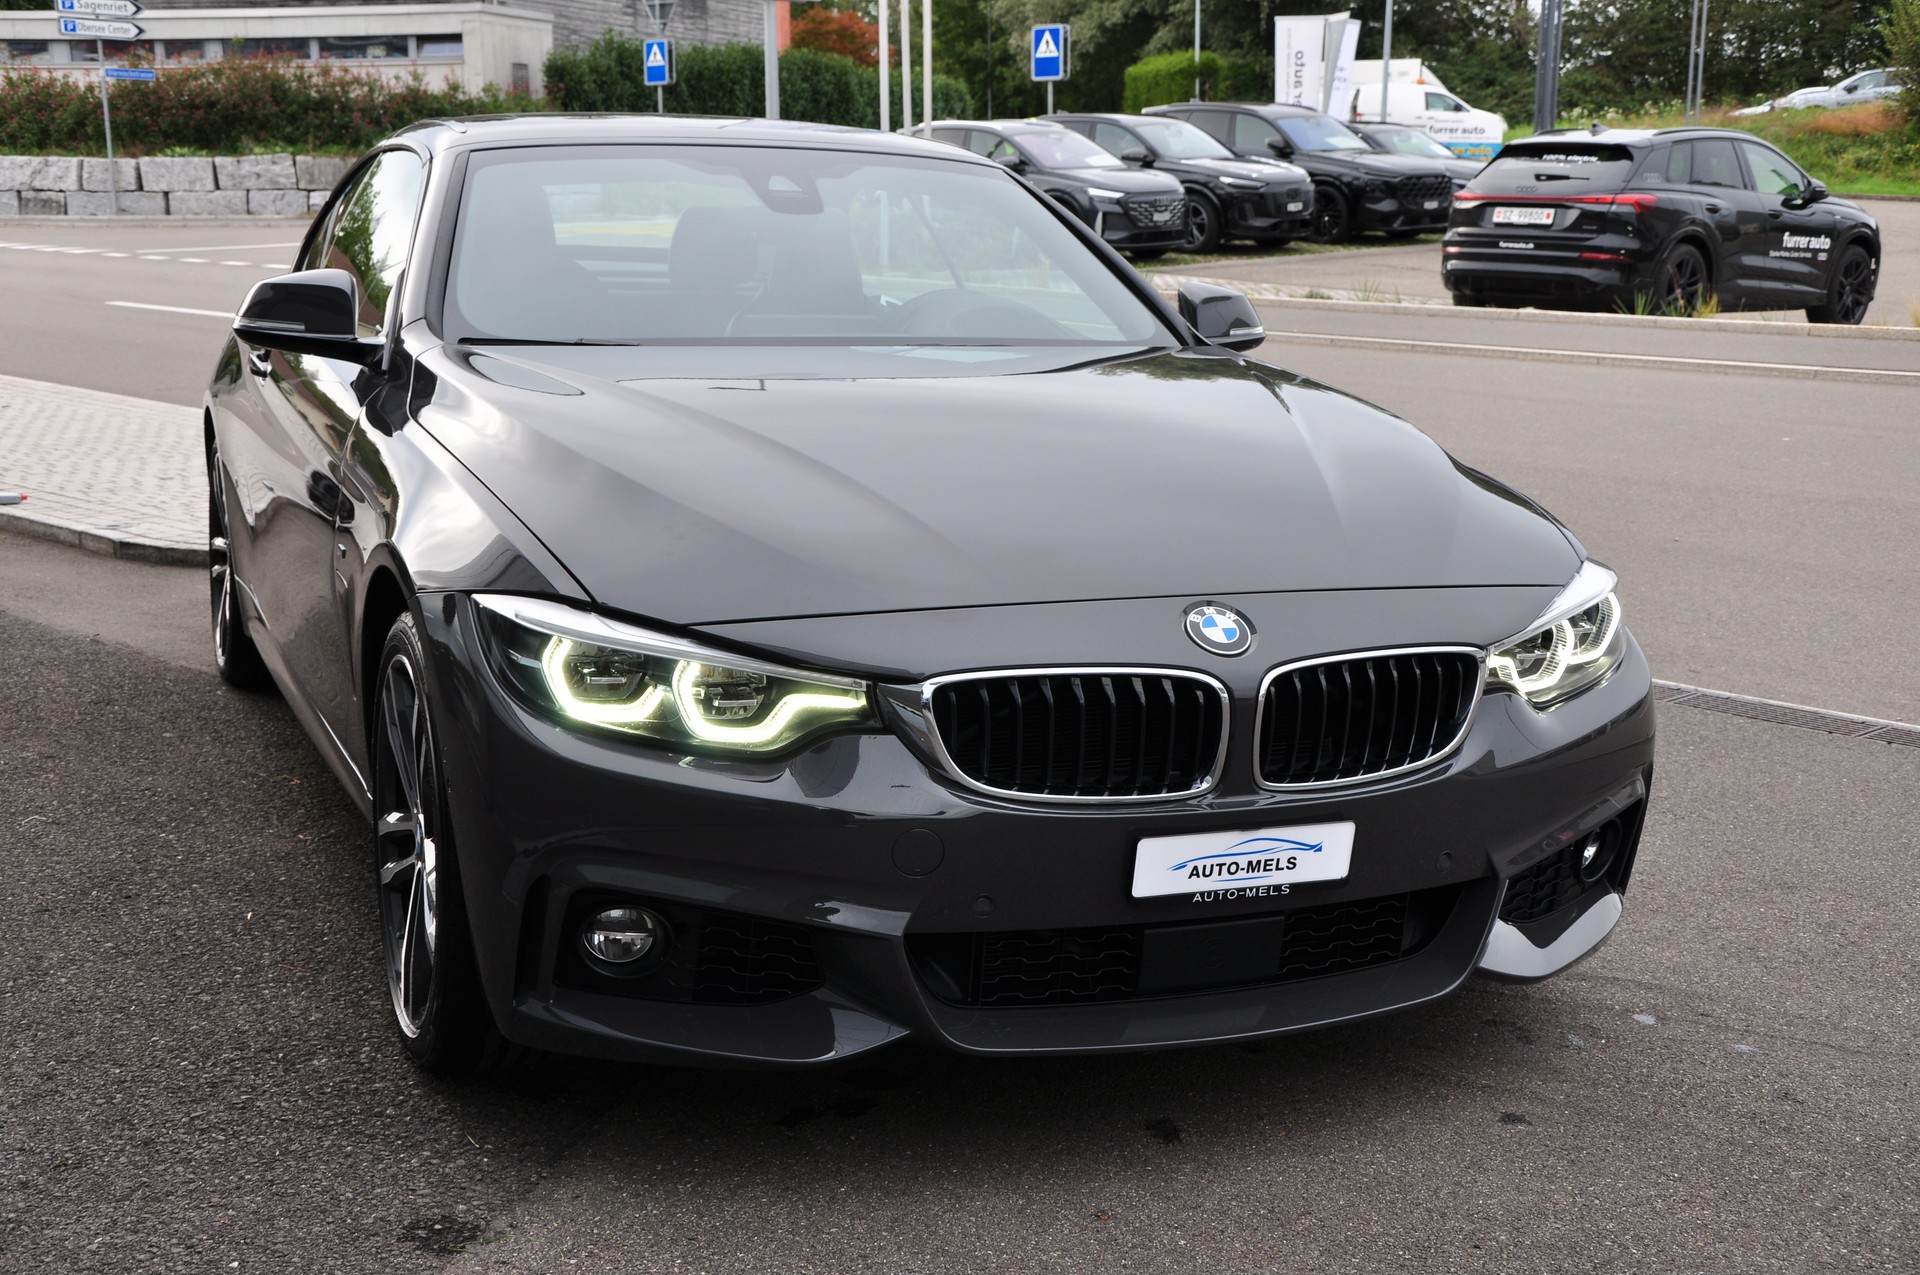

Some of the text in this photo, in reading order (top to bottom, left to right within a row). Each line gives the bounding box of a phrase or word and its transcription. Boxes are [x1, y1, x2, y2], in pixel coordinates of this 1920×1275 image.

[77, 0, 128, 13] Sagenriet
[78, 22, 106, 34] Obersee
[107, 24, 131, 35] Center
[1428, 125, 1486, 135] furrer auto
[1782, 231, 1831, 250] furrer auto
[1189, 607, 1239, 623] BMW
[1187, 856, 1298, 880] AUTO-MELS
[1192, 884, 1291, 903] AUTO-MELS
